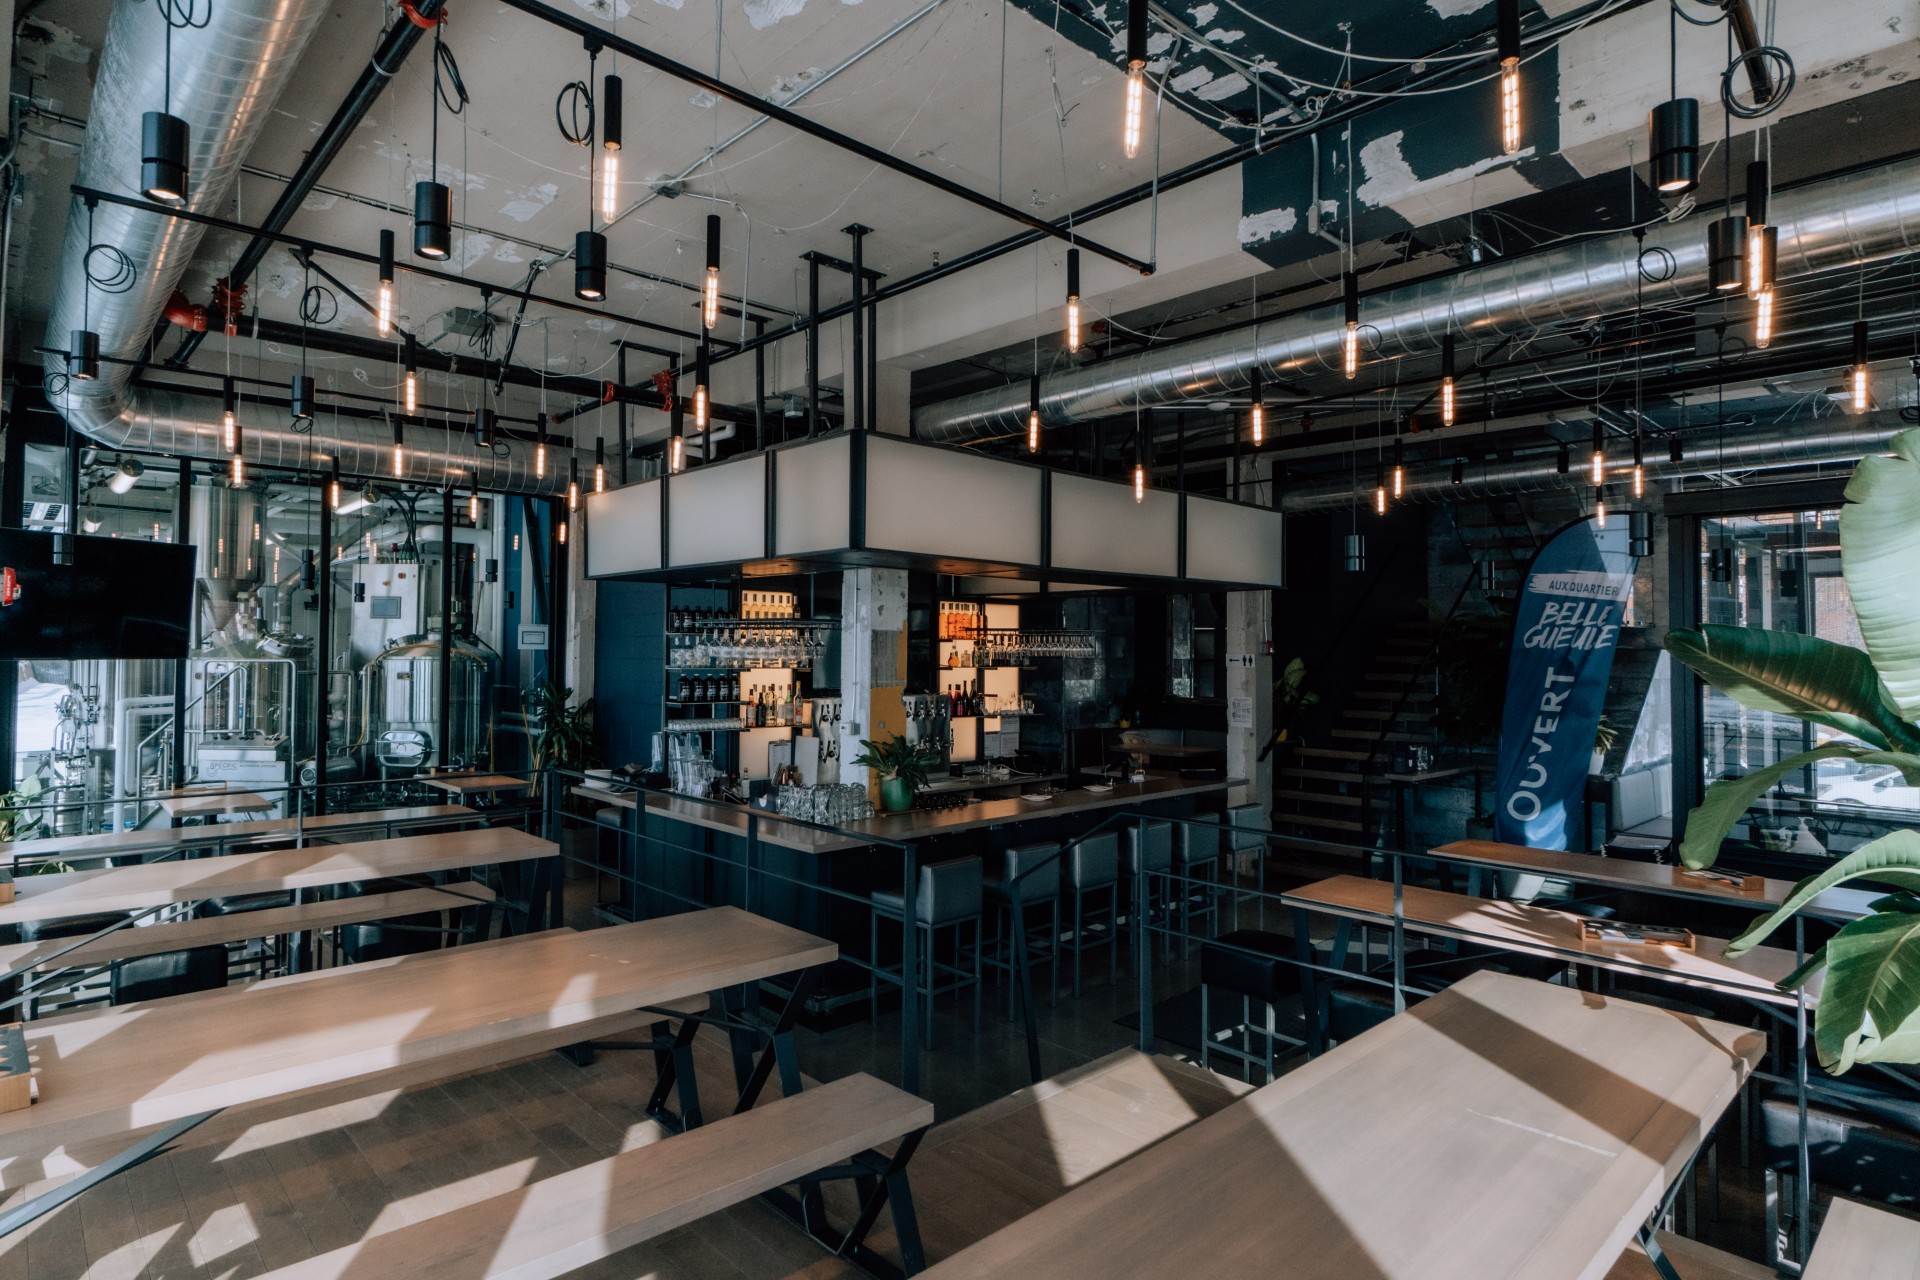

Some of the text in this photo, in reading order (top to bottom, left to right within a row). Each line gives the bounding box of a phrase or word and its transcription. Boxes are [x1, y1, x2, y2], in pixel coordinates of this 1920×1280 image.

[1540, 602, 1614, 630] BELLE
[1523, 624, 1618, 651] GUEULE
[1506, 666, 1575, 821] OUVERT
